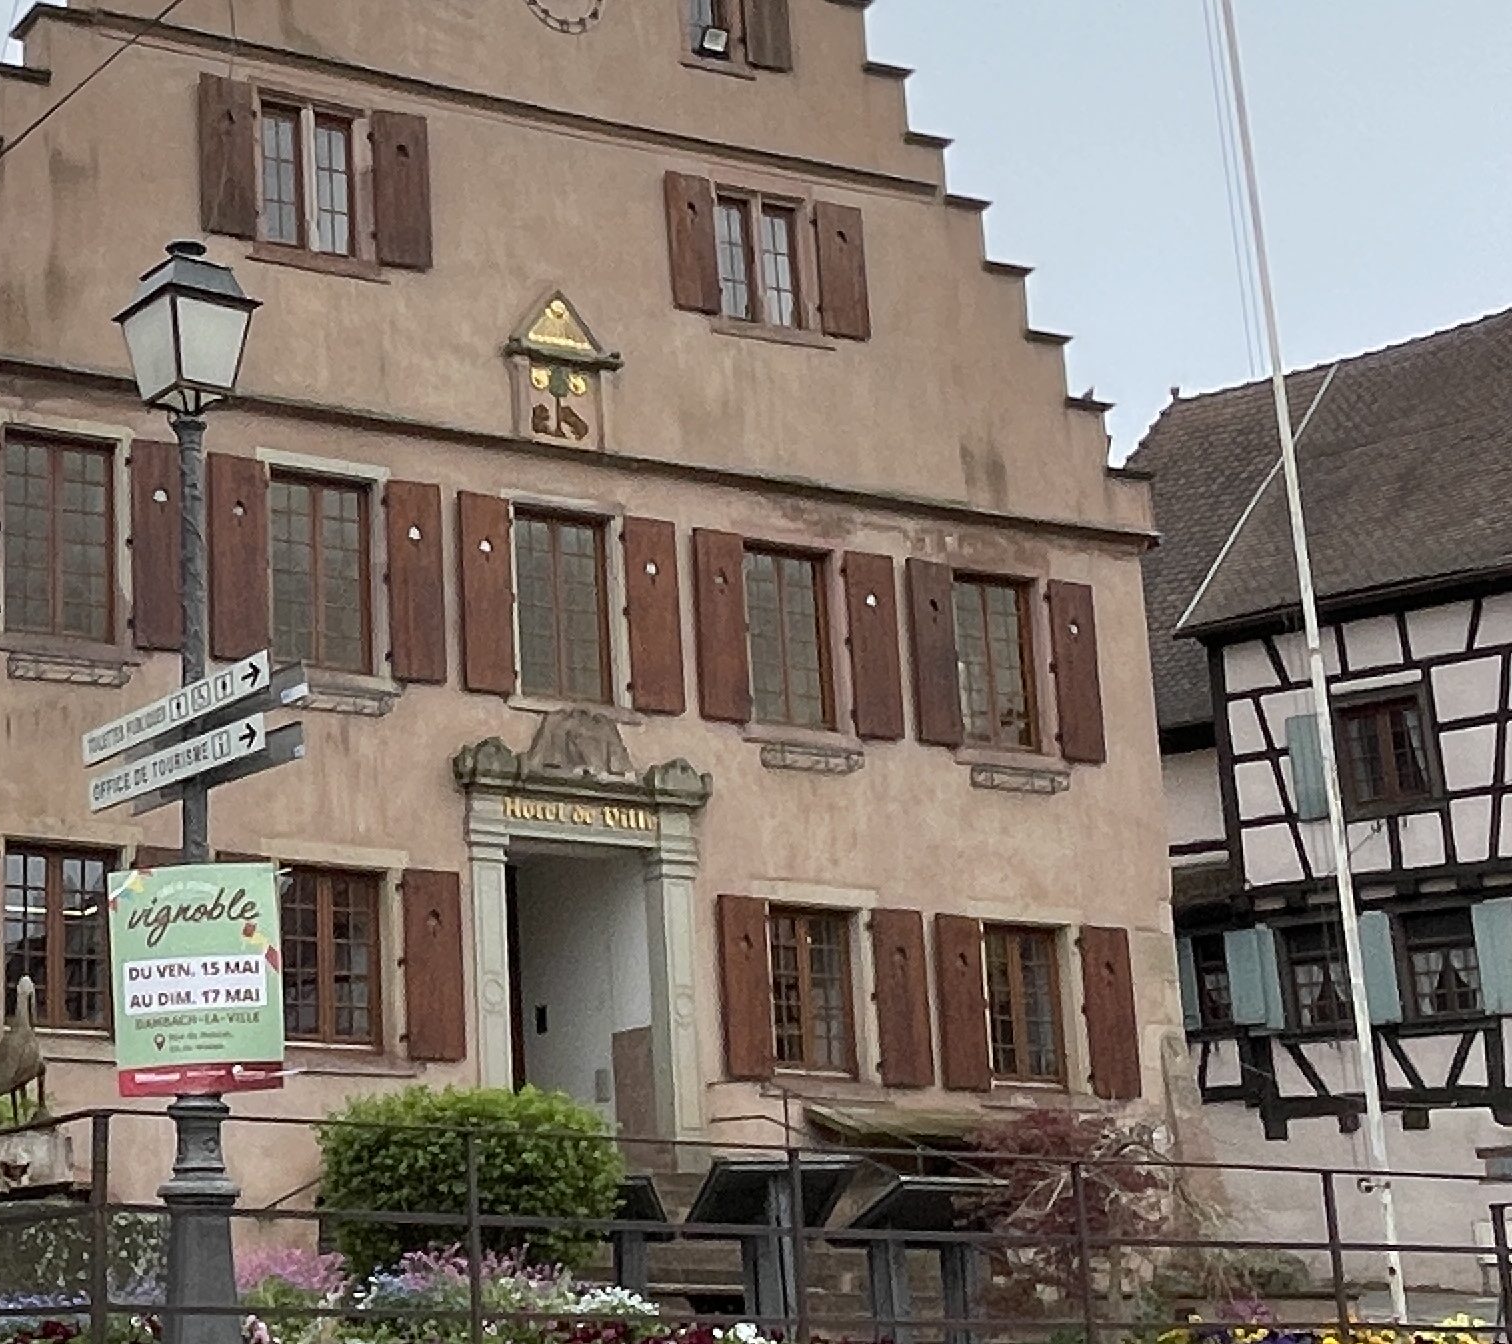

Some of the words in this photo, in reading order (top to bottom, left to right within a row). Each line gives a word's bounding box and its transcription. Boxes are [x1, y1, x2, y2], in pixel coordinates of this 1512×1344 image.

[93, 772, 131, 802] OFFICE
[134, 765, 148, 786] DE
[151, 742, 209, 778] TOURISME
[571, 803, 595, 825] de
[127, 887, 260, 948] vignoble
[128, 966, 152, 982] DU
[156, 963, 196, 978] VEN.
[201, 962, 220, 976] 15
[224, 960, 260, 975] MAI
[130, 994, 153, 1009] AU
[158, 991, 198, 1006] DIM.
[202, 989, 220, 1004] 17
[225, 988, 260, 1003] MAI
